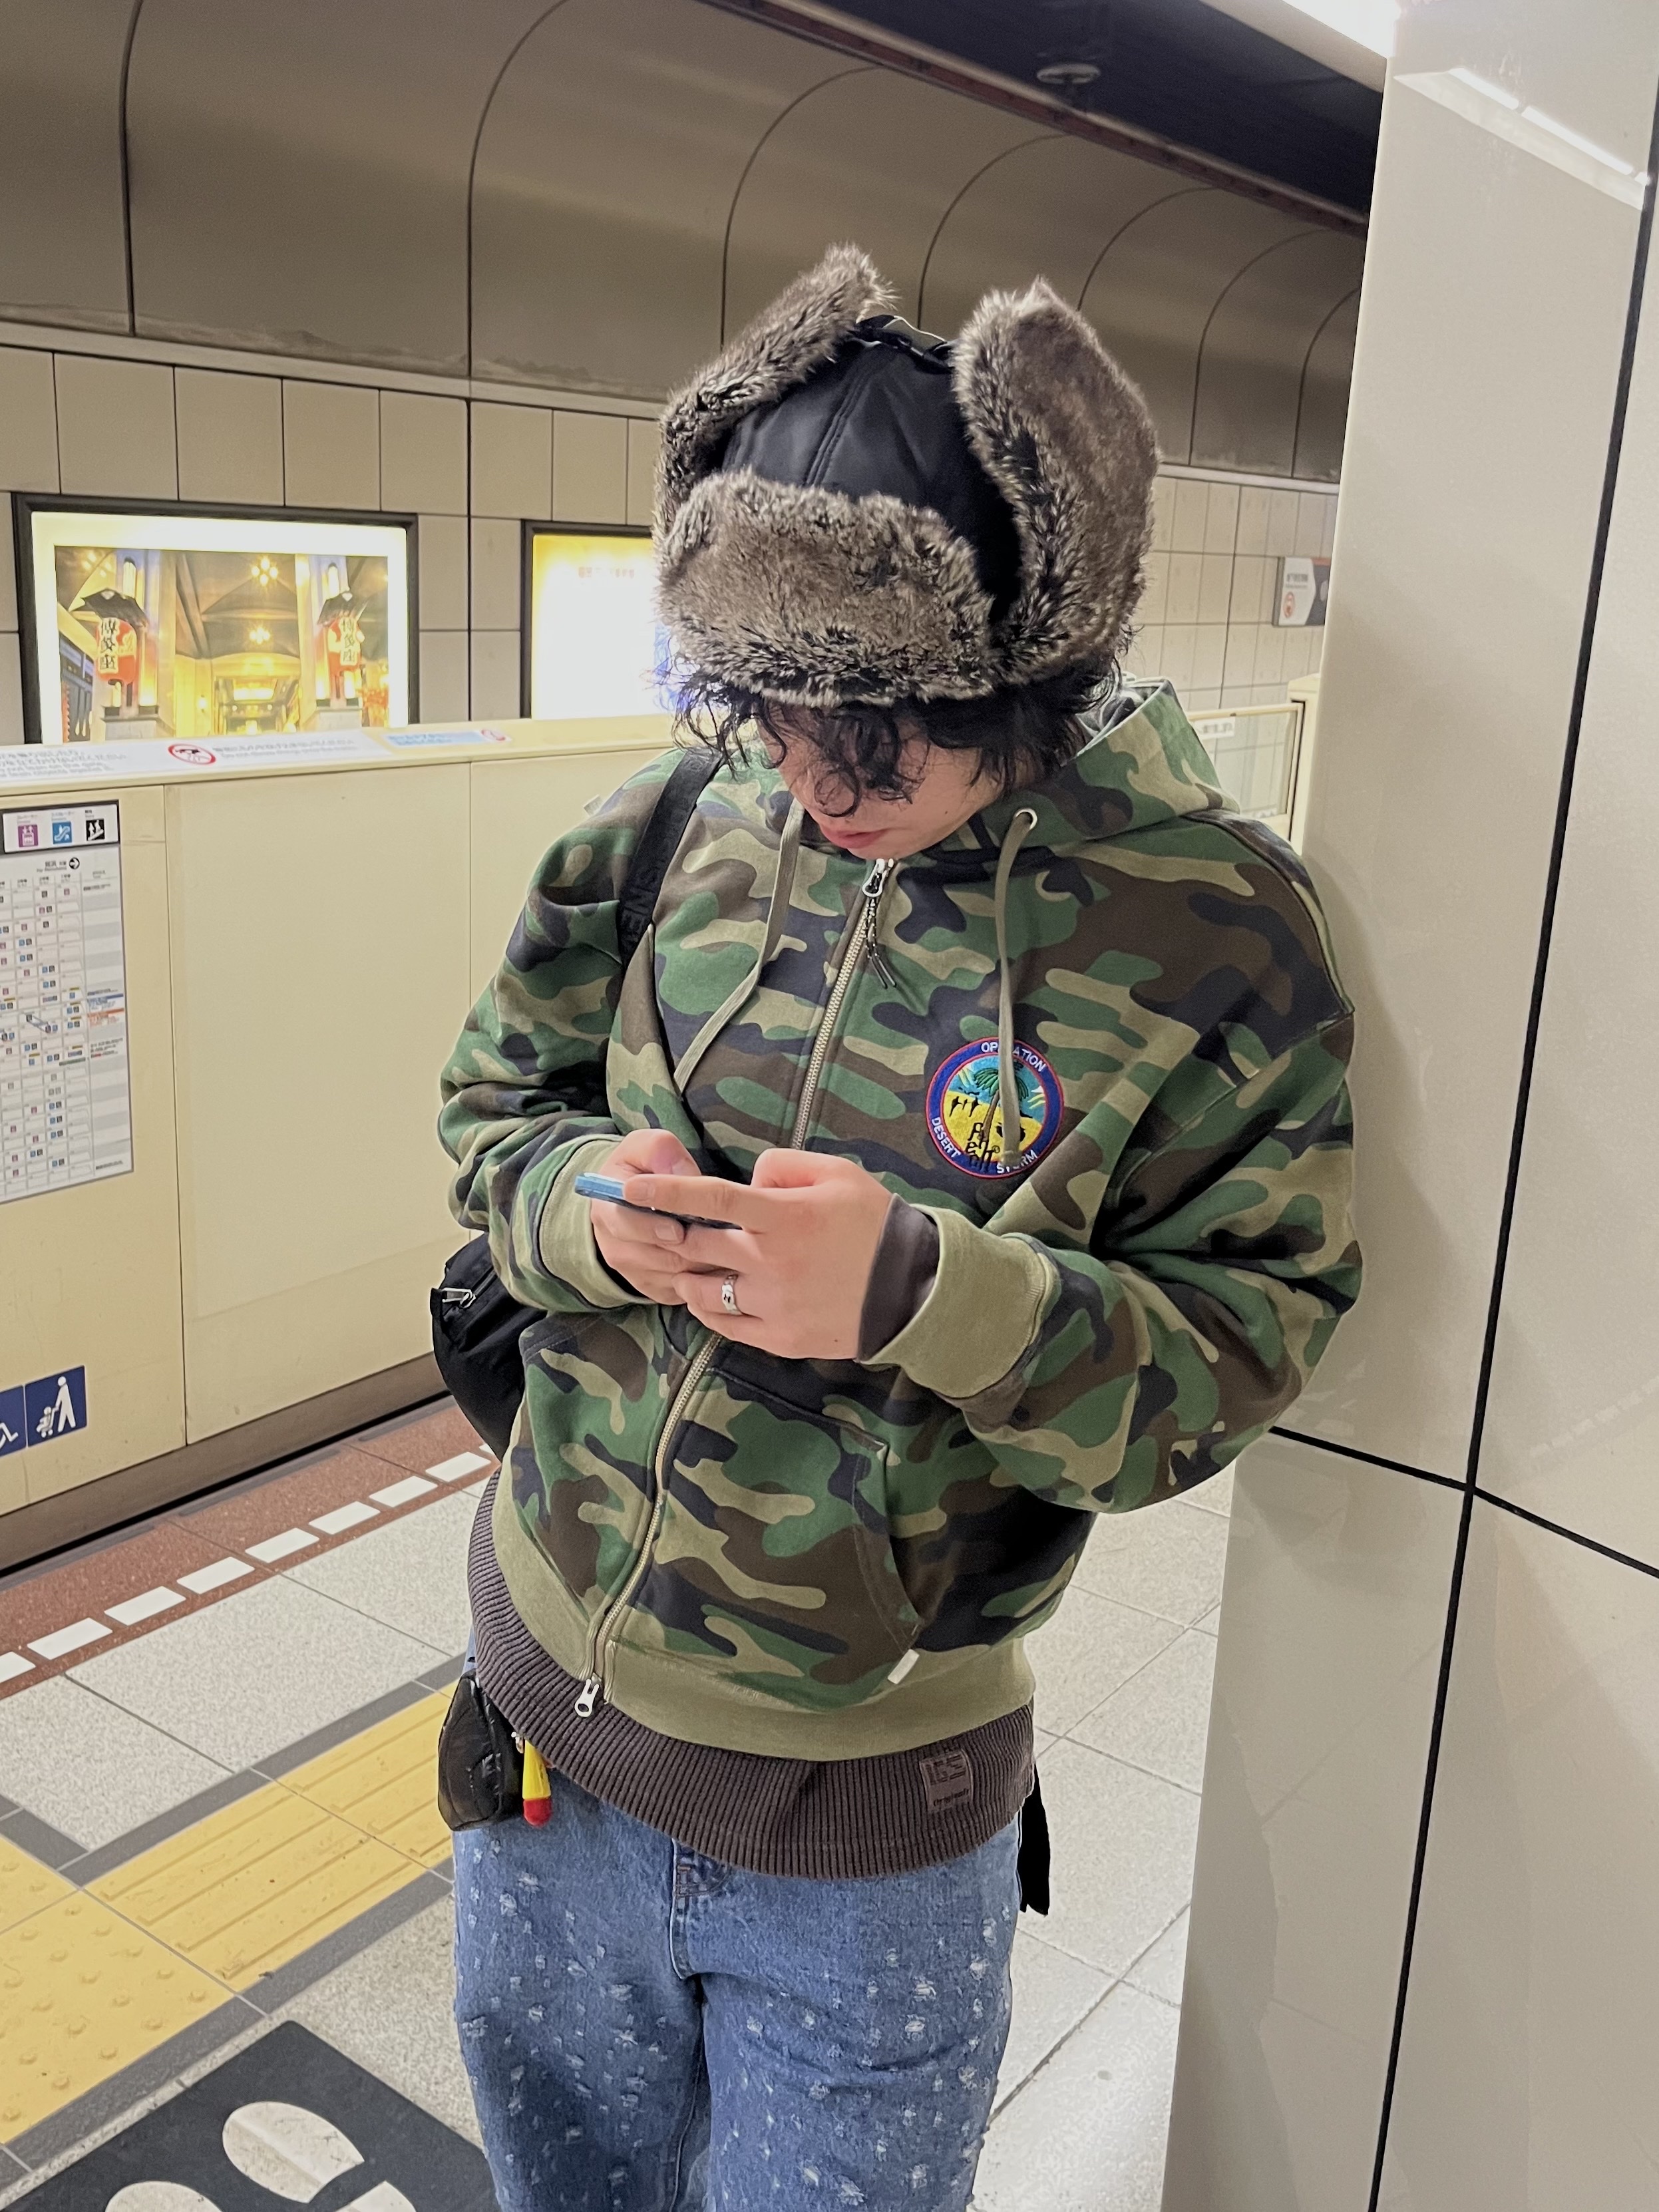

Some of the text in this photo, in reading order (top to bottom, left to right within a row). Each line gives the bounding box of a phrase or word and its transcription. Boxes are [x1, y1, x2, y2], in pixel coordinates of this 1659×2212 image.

[981, 1041, 1047, 1072] OPATION
[931, 1117, 962, 1159] DESERT
[996, 1149, 1039, 1174] SRM
